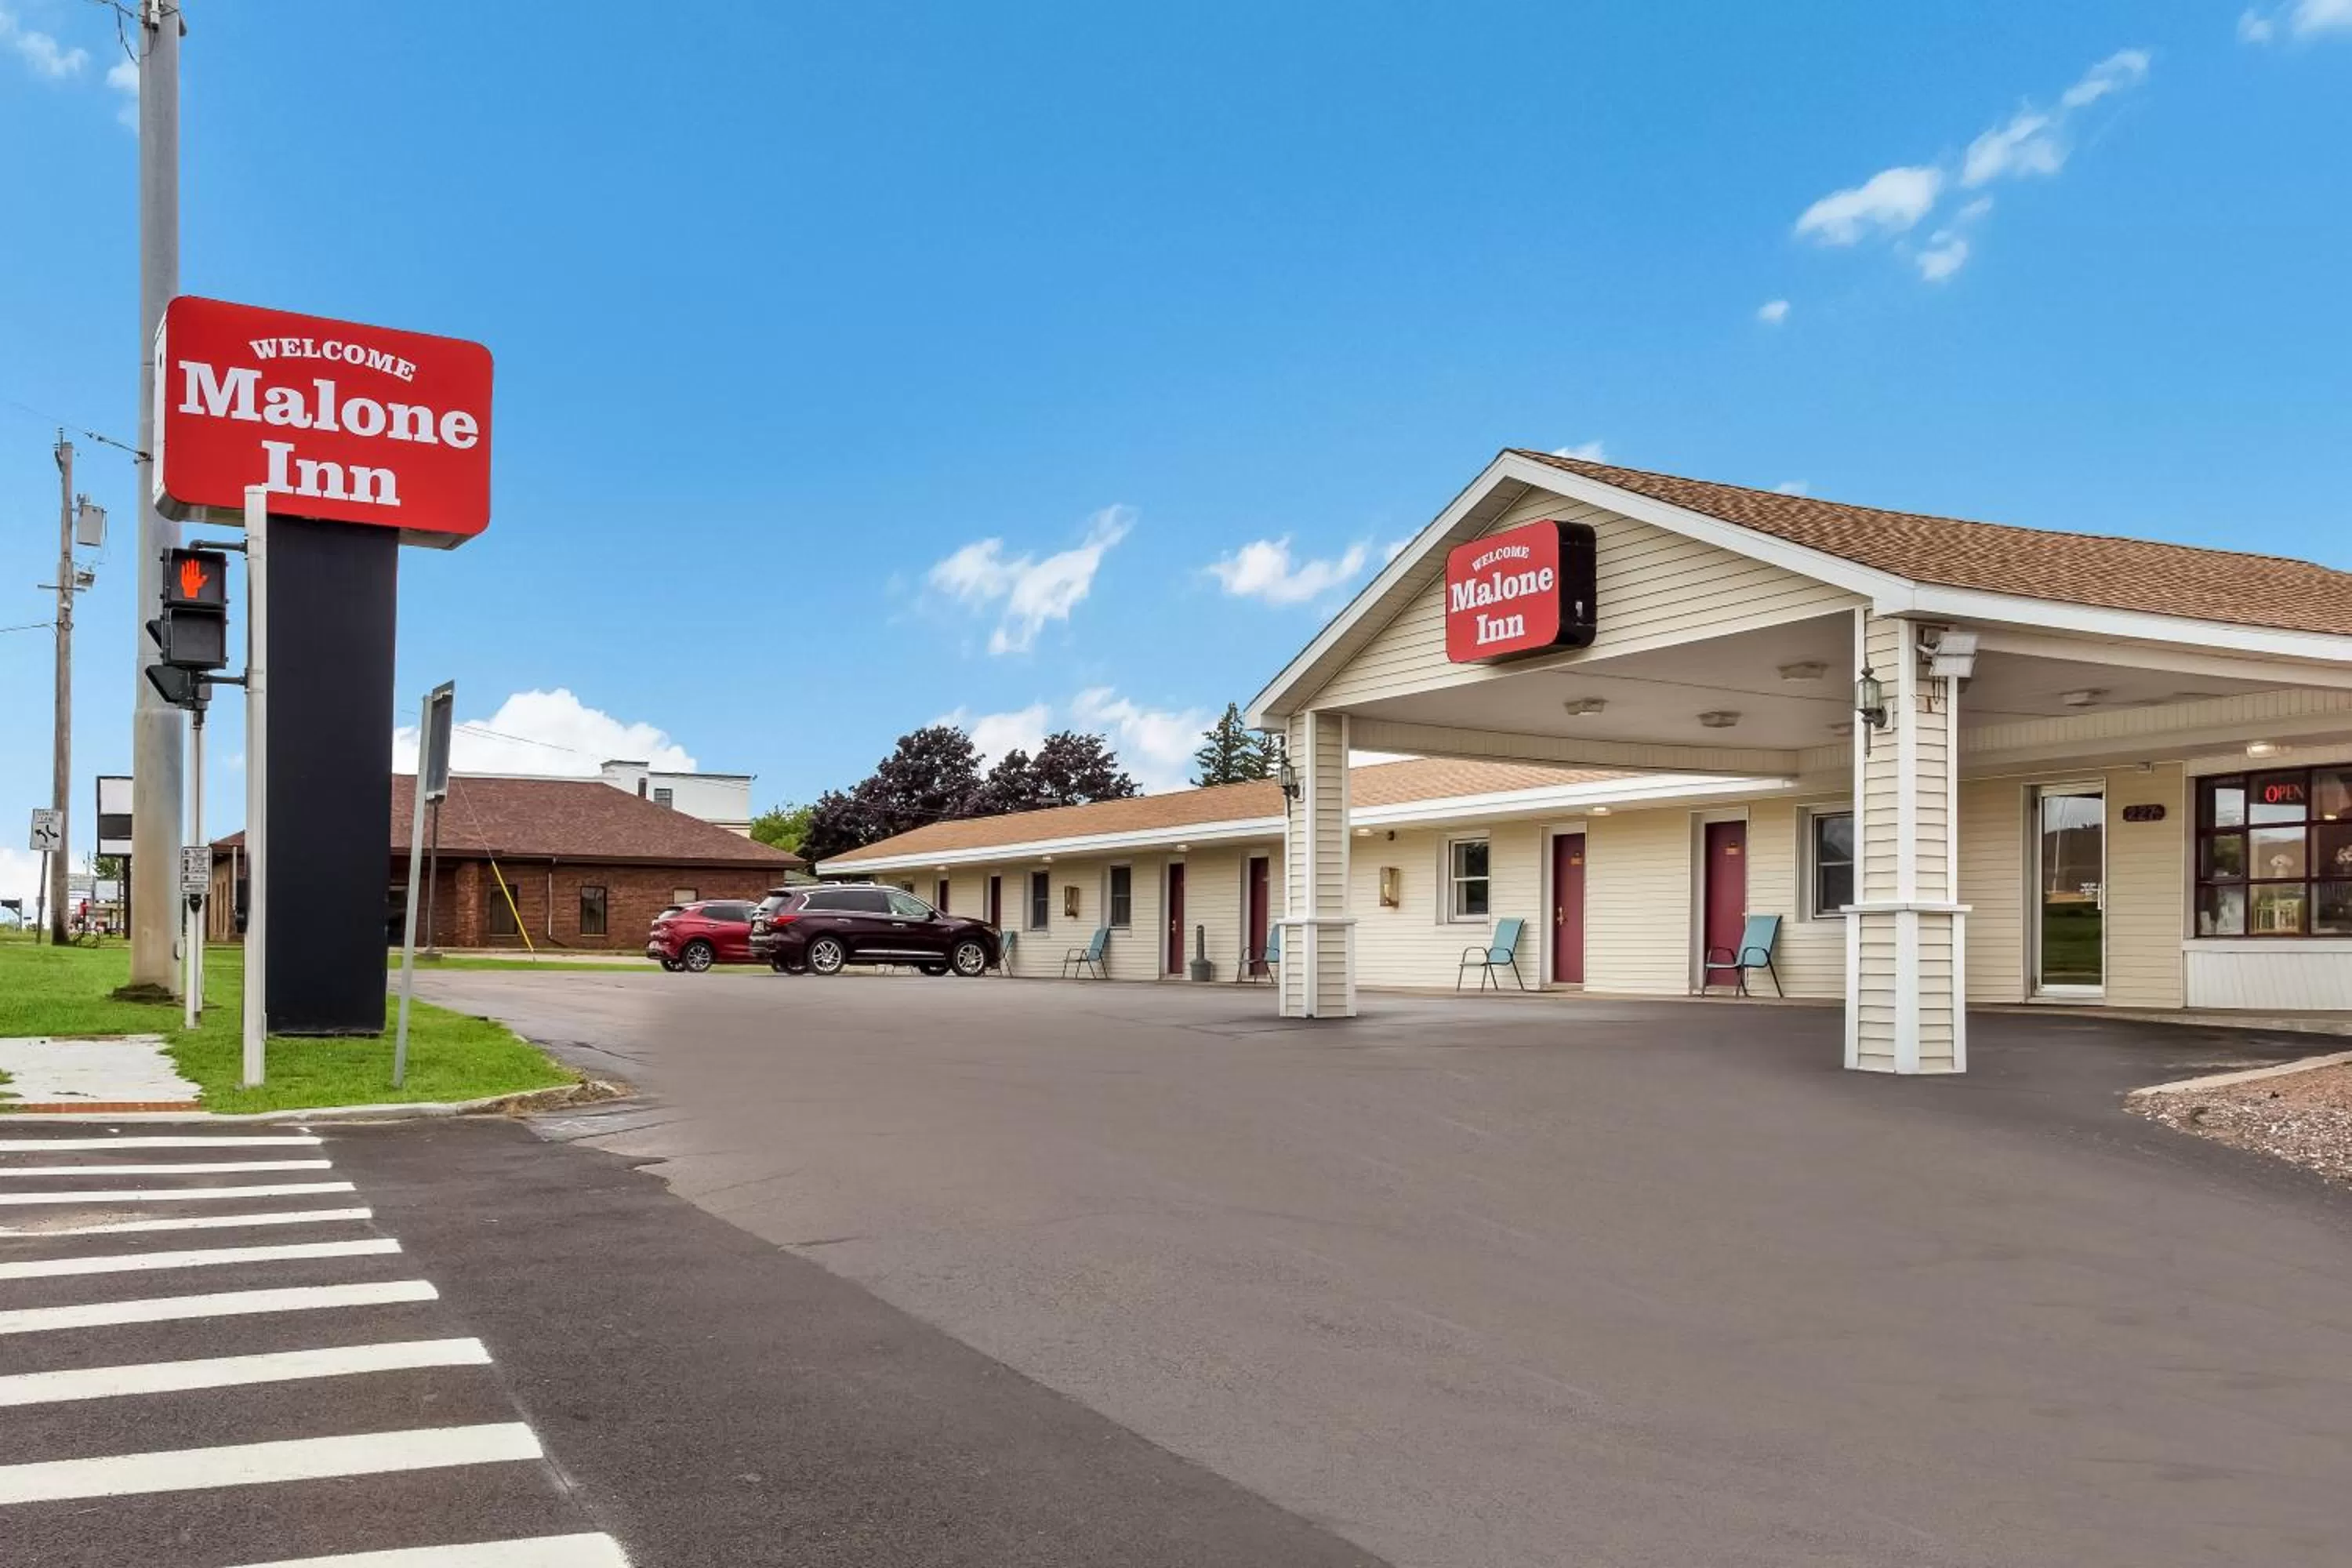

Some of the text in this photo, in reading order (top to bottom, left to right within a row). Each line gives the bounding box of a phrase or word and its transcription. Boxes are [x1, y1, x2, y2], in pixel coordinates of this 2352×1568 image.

[250, 338, 416, 382] WELCOME
[179, 361, 478, 448] Malone
[261, 440, 401, 506] Inn
[1472, 546, 1530, 572] WELCOME
[1450, 567, 1554, 612] Malone
[1475, 613, 1525, 645] Inn
[2265, 783, 2304, 803] OPEN
